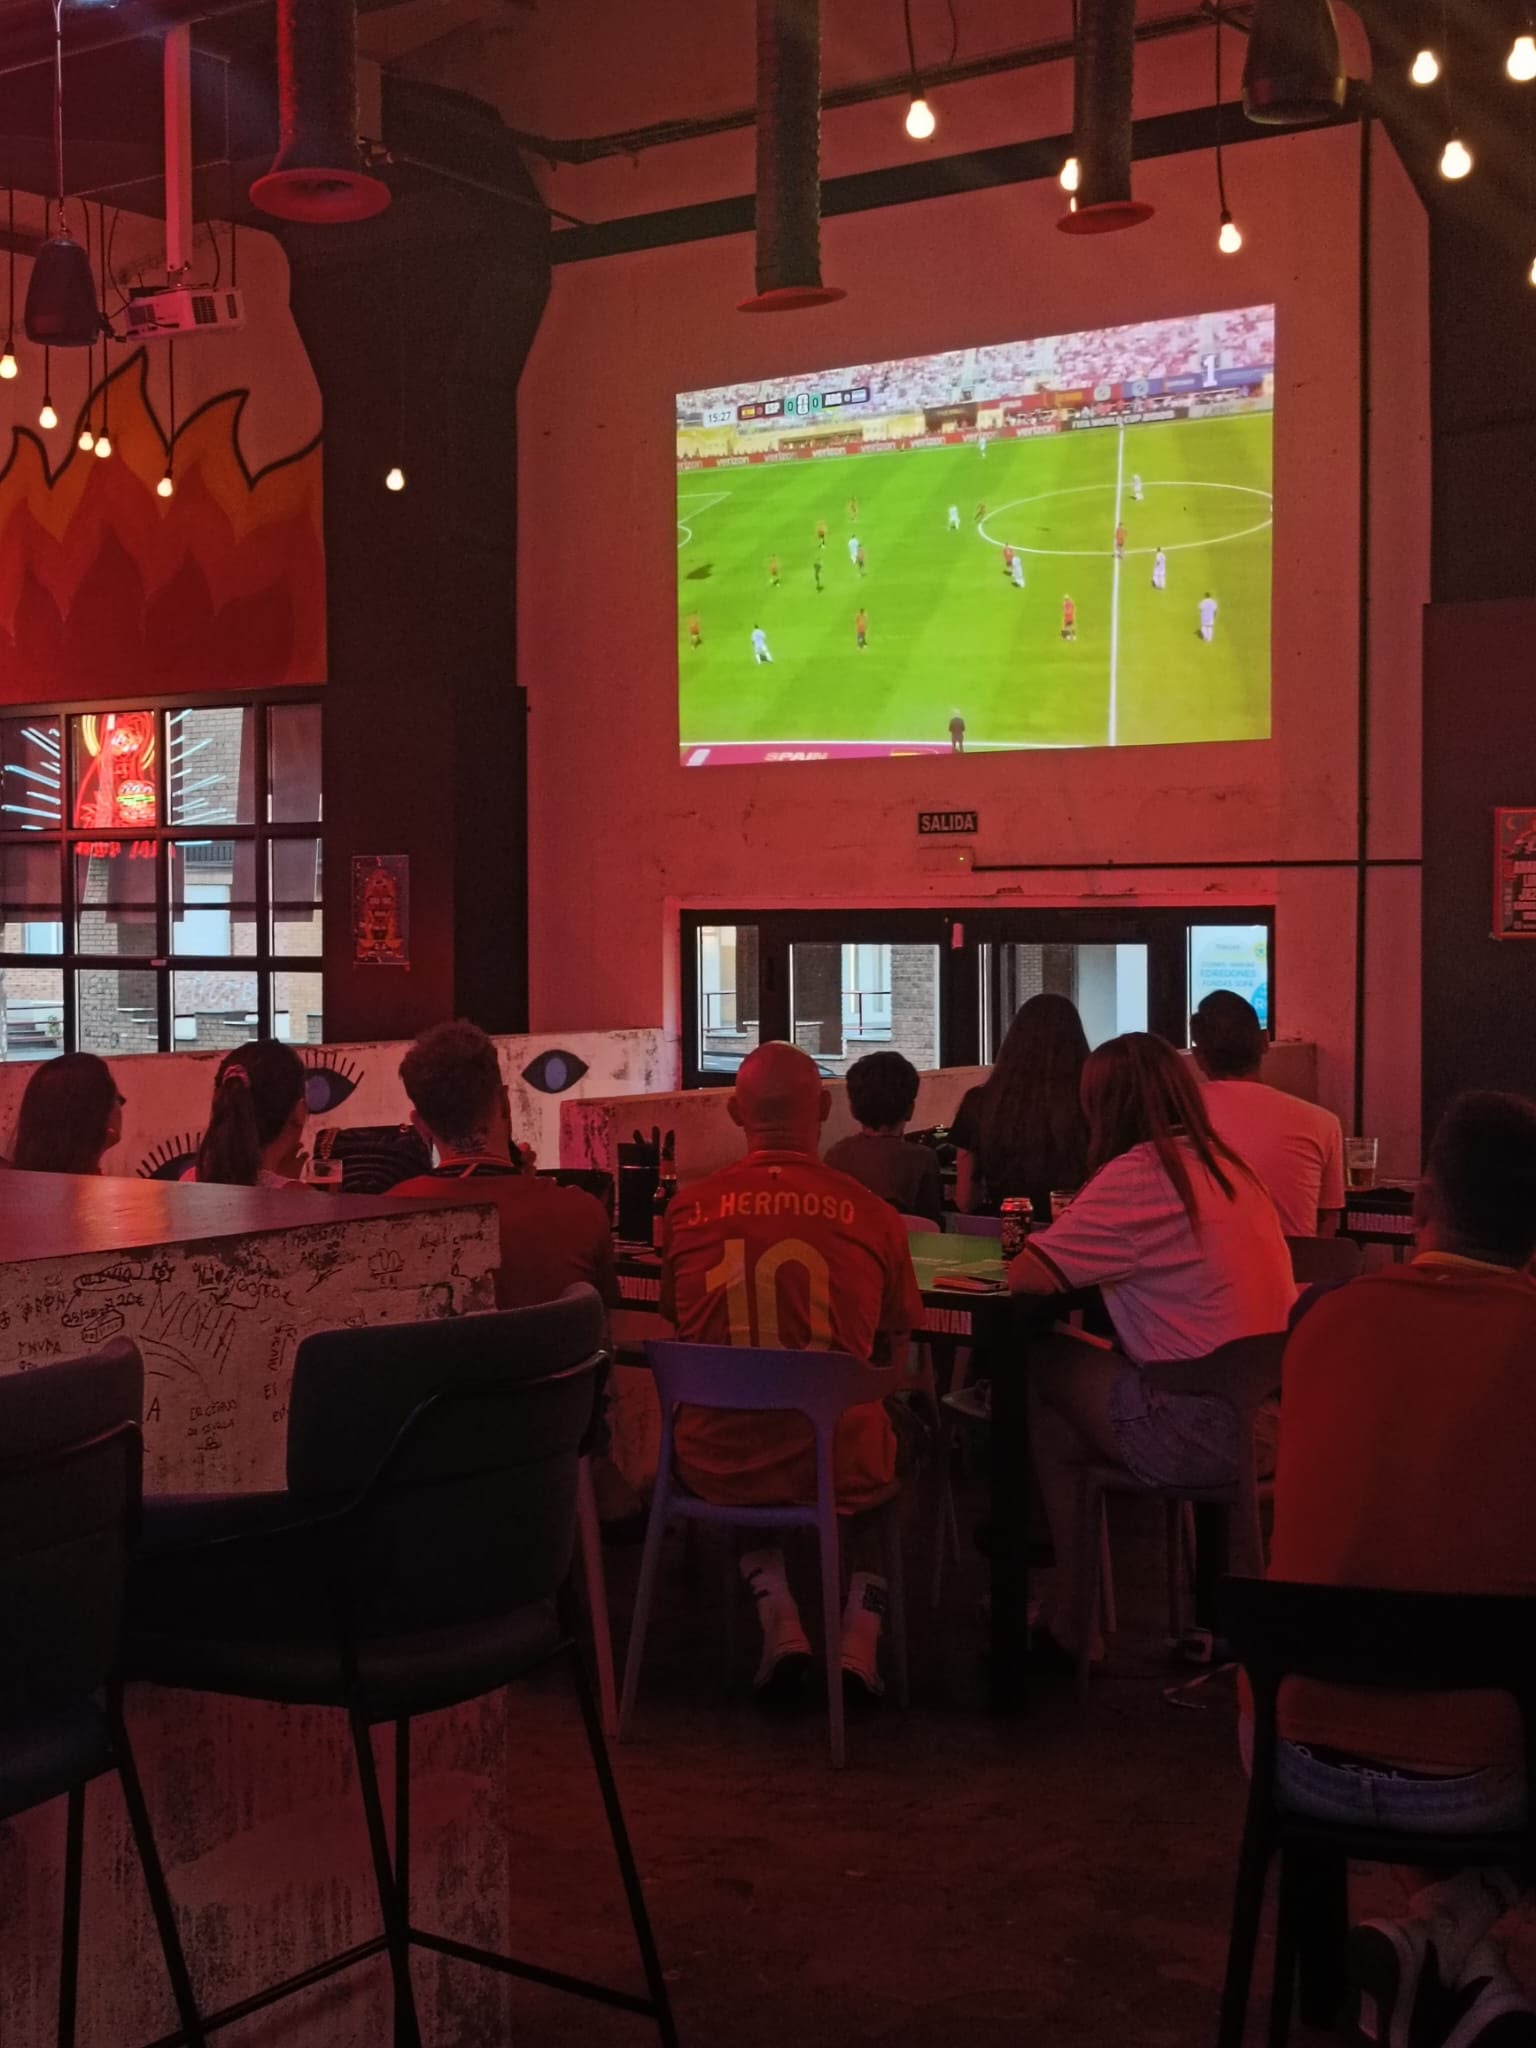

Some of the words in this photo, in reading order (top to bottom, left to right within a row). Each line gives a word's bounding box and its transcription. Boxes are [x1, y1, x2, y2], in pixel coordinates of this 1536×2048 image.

[708, 411, 732, 423] 15:27
[764, 751, 829, 763] SPAIN
[920, 813, 975, 832] SALIDA
[687, 1200, 710, 1227] J.
[719, 1191, 856, 1226] HERMOSO
[704, 1237, 833, 1353] 10
